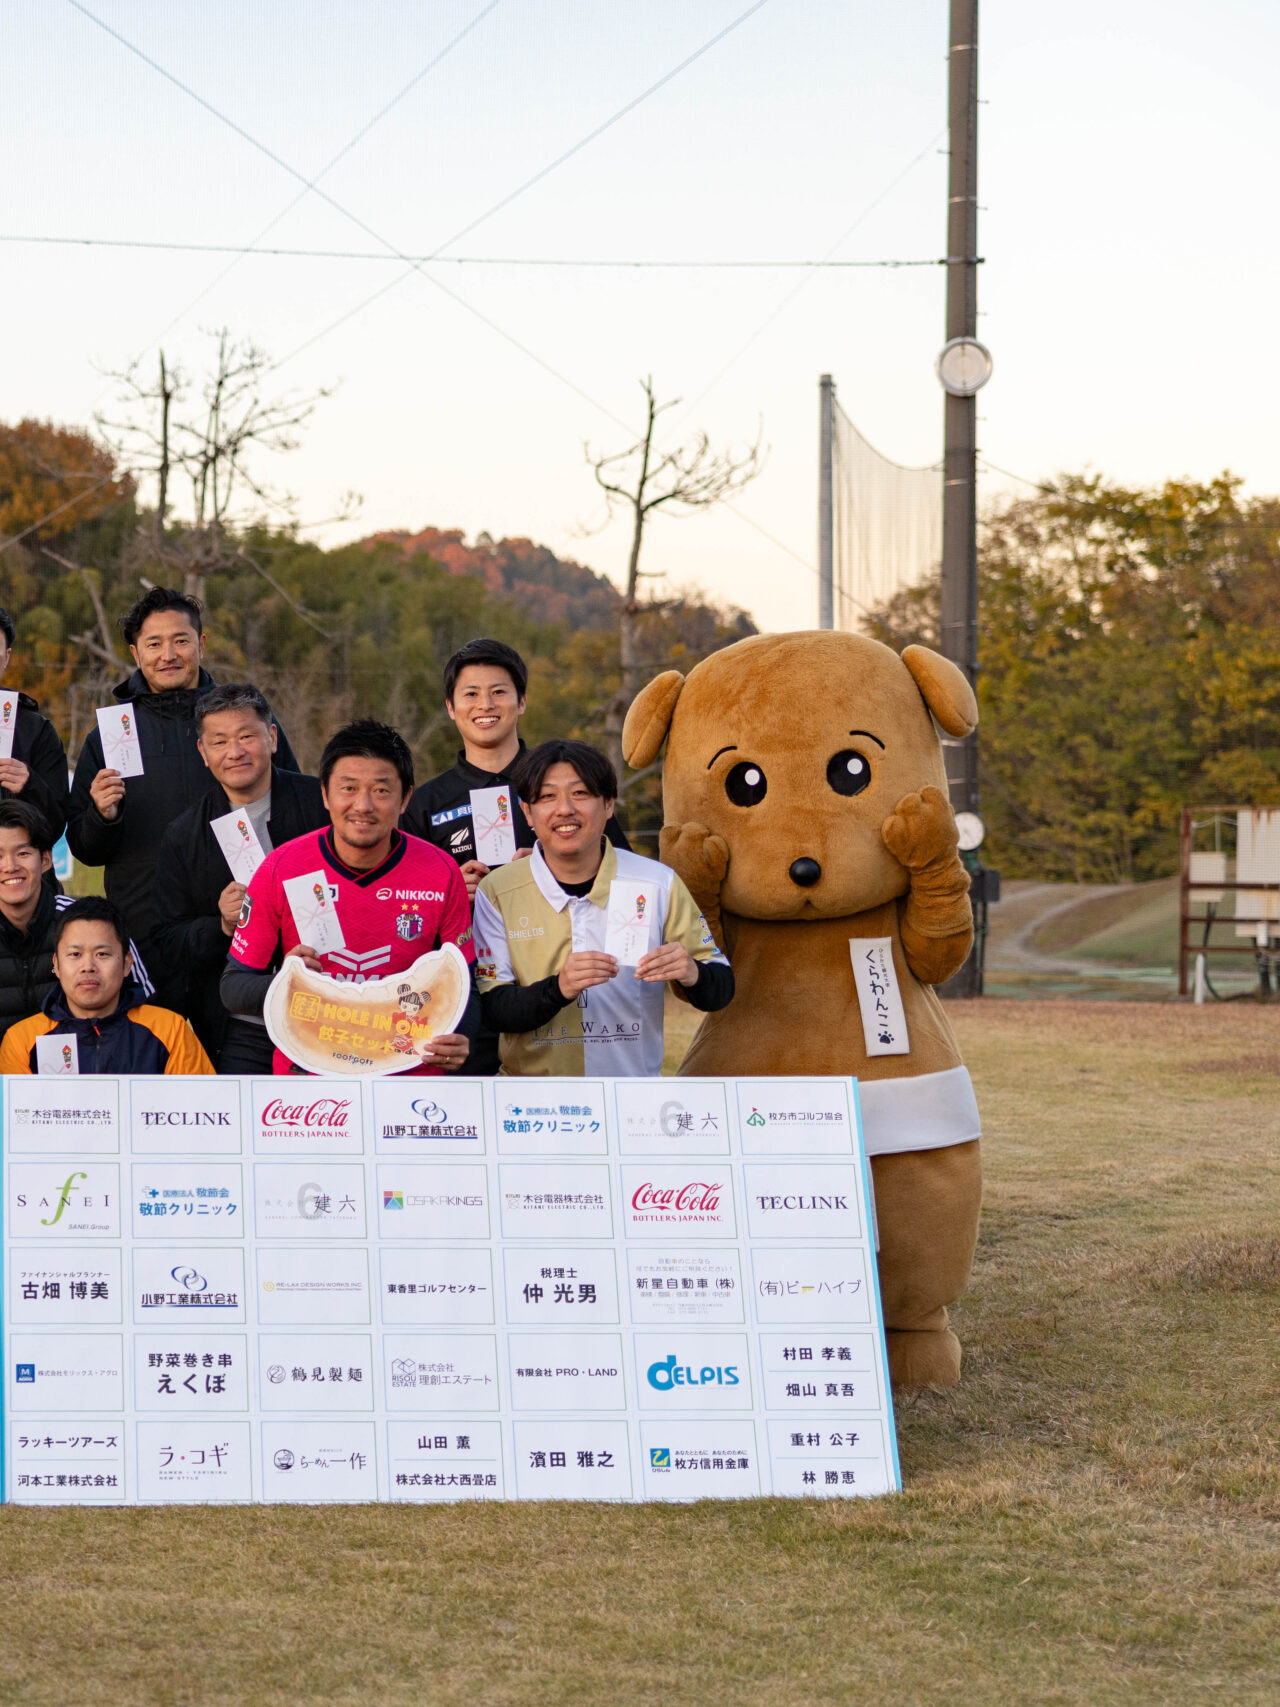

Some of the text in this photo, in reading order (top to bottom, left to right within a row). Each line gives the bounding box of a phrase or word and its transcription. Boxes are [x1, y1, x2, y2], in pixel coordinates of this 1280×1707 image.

[395, 889, 444, 902] NIKKON
[866, 949, 889, 1027] くらわんこ
[323, 1003, 434, 1039] HOLE IN ONE
[580, 1021, 640, 1034] WAKO
[318, 1026, 396, 1055] 餃子セット
[32, 1110, 111, 1119] 木谷電器株式会社
[141, 1112, 230, 1125] TECLINK
[262, 1099, 351, 1127] Coca-Cola
[769, 1112, 842, 1120] 枚方市ゴルフ協会
[503, 1120, 600, 1133] 敬節クリニック
[676, 1112, 718, 1131] 建六
[383, 1125, 477, 1137] 小野工業株式会社
[524, 1194, 603, 1203] 木谷電器株式会社
[632, 1183, 722, 1211] Coca-Cola
[756, 1196, 848, 1209] TECLINK
[139, 1203, 237, 1216] 敬節クリニック
[314, 1194, 355, 1215] 建六
[541, 1268, 577, 1278] 税理士
[21, 1281, 108, 1299] 古畑 博美
[388, 1284, 486, 1293] 東香里ゴルフセンター
[523, 1283, 596, 1303] 仲 光男
[759, 1279, 861, 1296] (有)ビーハイブ
[142, 1293, 237, 1305] 小野工業株式会社
[149, 1353, 232, 1367] 野菜巻き串
[783, 1347, 851, 1360] 村田 孝義
[418, 1363, 454, 1372] 株式会社
[516, 1368, 552, 1377] 有限会社
[292, 1367, 362, 1382] 鶴見製麺
[419, 1375, 491, 1385] 理創エステート
[157, 1374, 226, 1394] えくぼ
[786, 1383, 854, 1396] 畑山 真吾
[19, 1436, 117, 1448] ラッキーツアーズ
[418, 1436, 470, 1449] 山田 薫
[791, 1433, 859, 1446] 重村 公子
[160, 1443, 228, 1467] ラ・コギ
[530, 1451, 614, 1468] 濱田 雅之
[675, 1458, 749, 1469] 枚方信用金庫
[18, 1475, 118, 1486] 河本工業株式会社
[396, 1474, 496, 1485] 株式会社大西畳店
[802, 1471, 855, 1484] 林 勝恵
